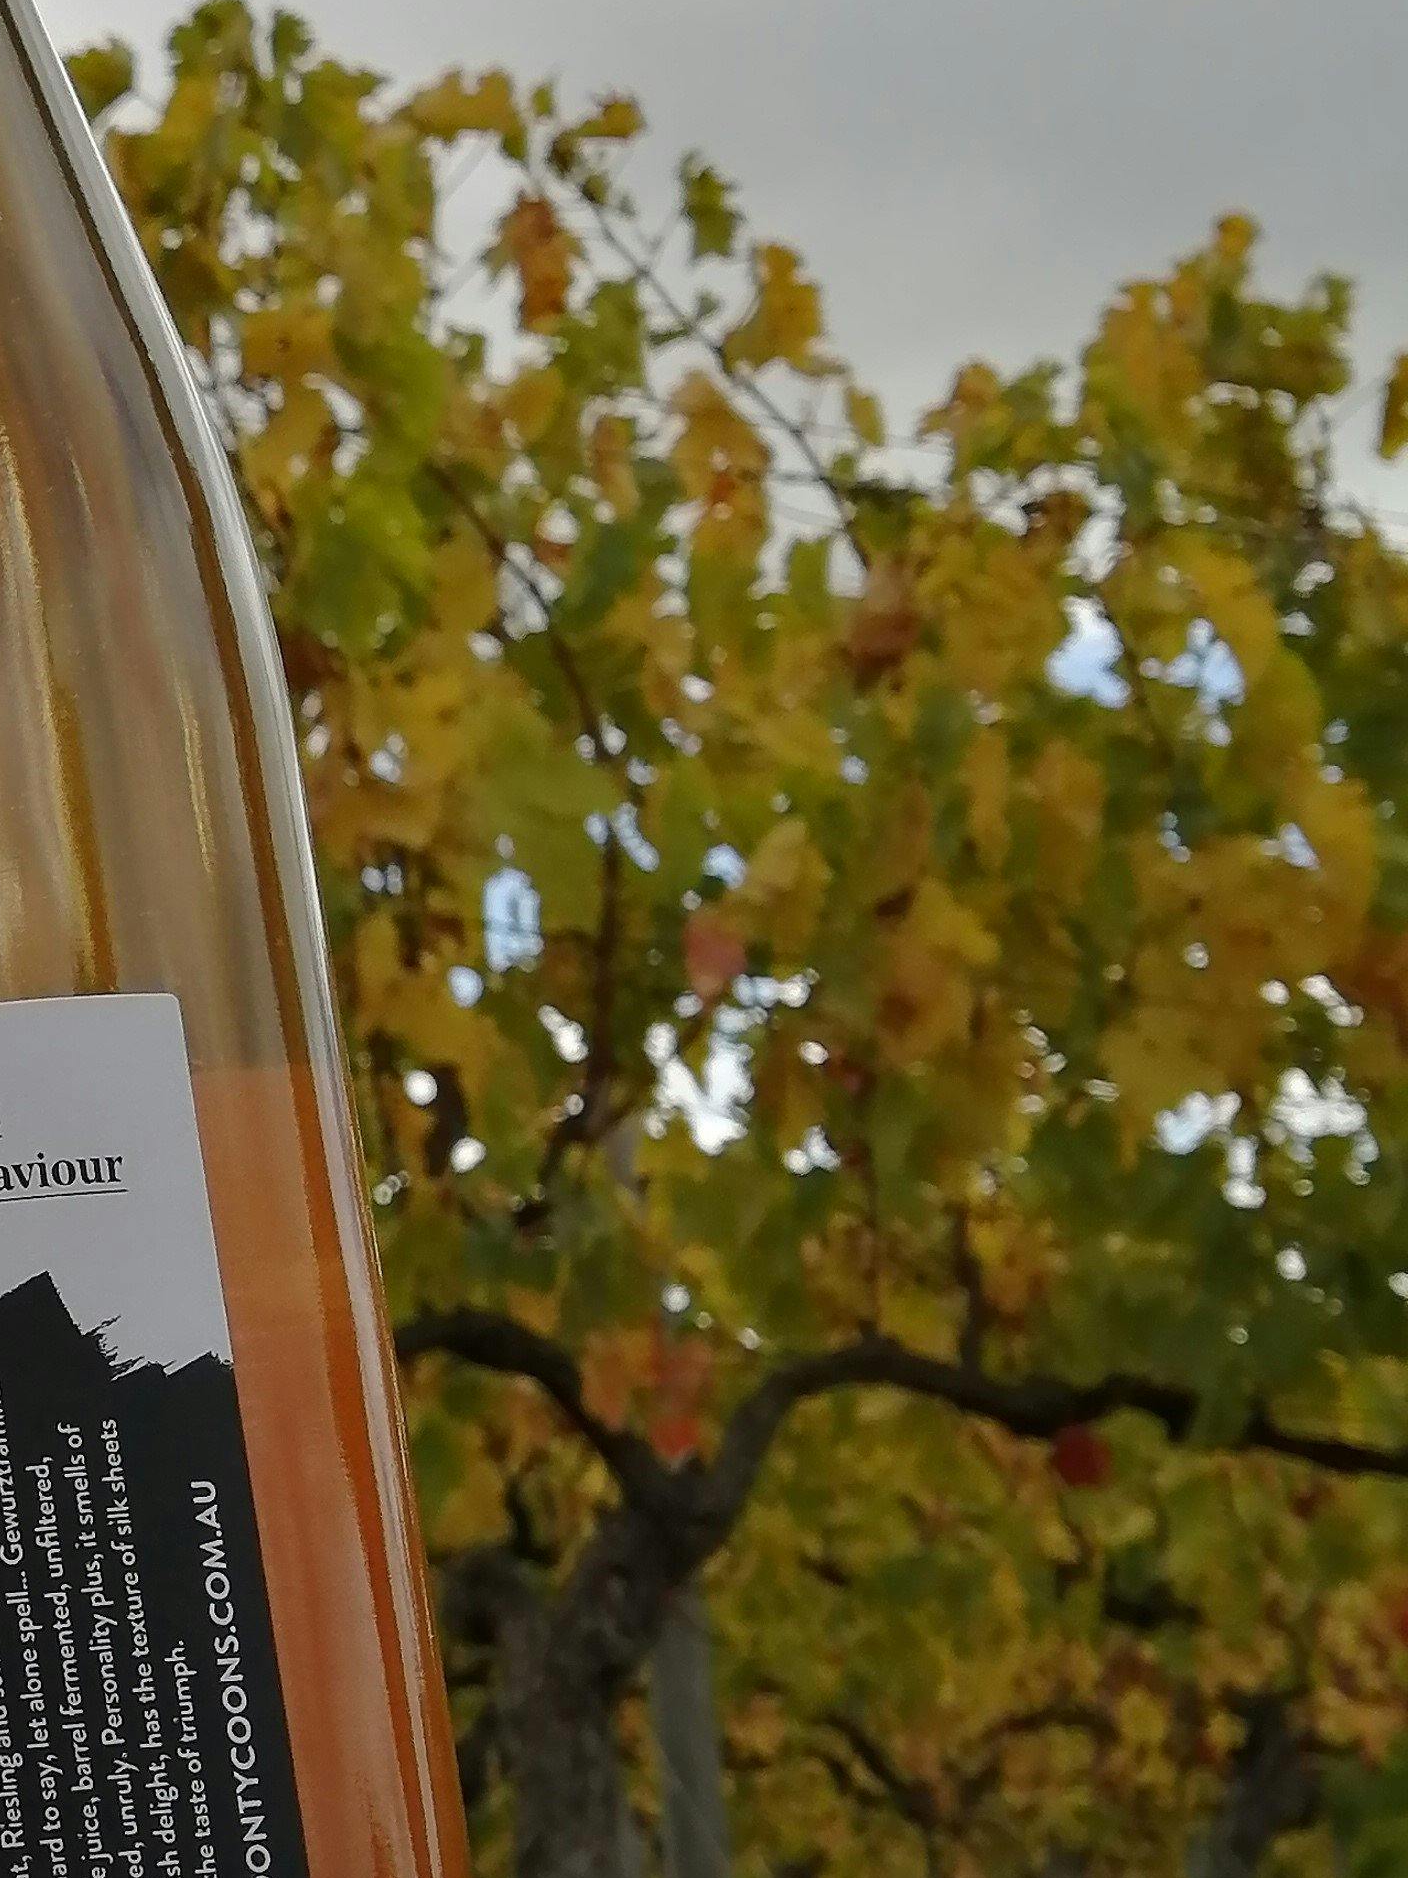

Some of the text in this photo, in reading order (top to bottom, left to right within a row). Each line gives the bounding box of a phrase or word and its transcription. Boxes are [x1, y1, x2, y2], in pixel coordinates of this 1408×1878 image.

[57, 1421, 83, 1449] of
[100, 1419, 126, 1493] sheets
[24, 1456, 64, 1578] unfiltered,
[62, 1454, 94, 1526] smells
[105, 1496, 133, 1536] silk
[74, 1530, 98, 1550] it
[110, 1540, 136, 1566] of
[80, 1553, 115, 1607] plus,
[124, 1571, 150, 1658] texture
[19, 1648, 46, 1712] alone
[43, 1583, 84, 1717] fermented,
[88, 1613, 126, 1746] Personality
[131, 1662, 157, 1704] the
[163, 1639, 198, 1743] triumph.
[26, 1717, 50, 1749] let
[61, 1722, 94, 1792] barrel
[139, 1708, 163, 1749] has
[36, 1754, 64, 1798] say,
[176, 1747, 202, 1774] of
[42, 1806, 62, 1832] to
[106, 1752, 140, 1836] unruly.
[144, 1754, 180, 1844] delight,
[189, 1779, 211, 1838] taste
[82, 1796, 114, 1865] juice,
